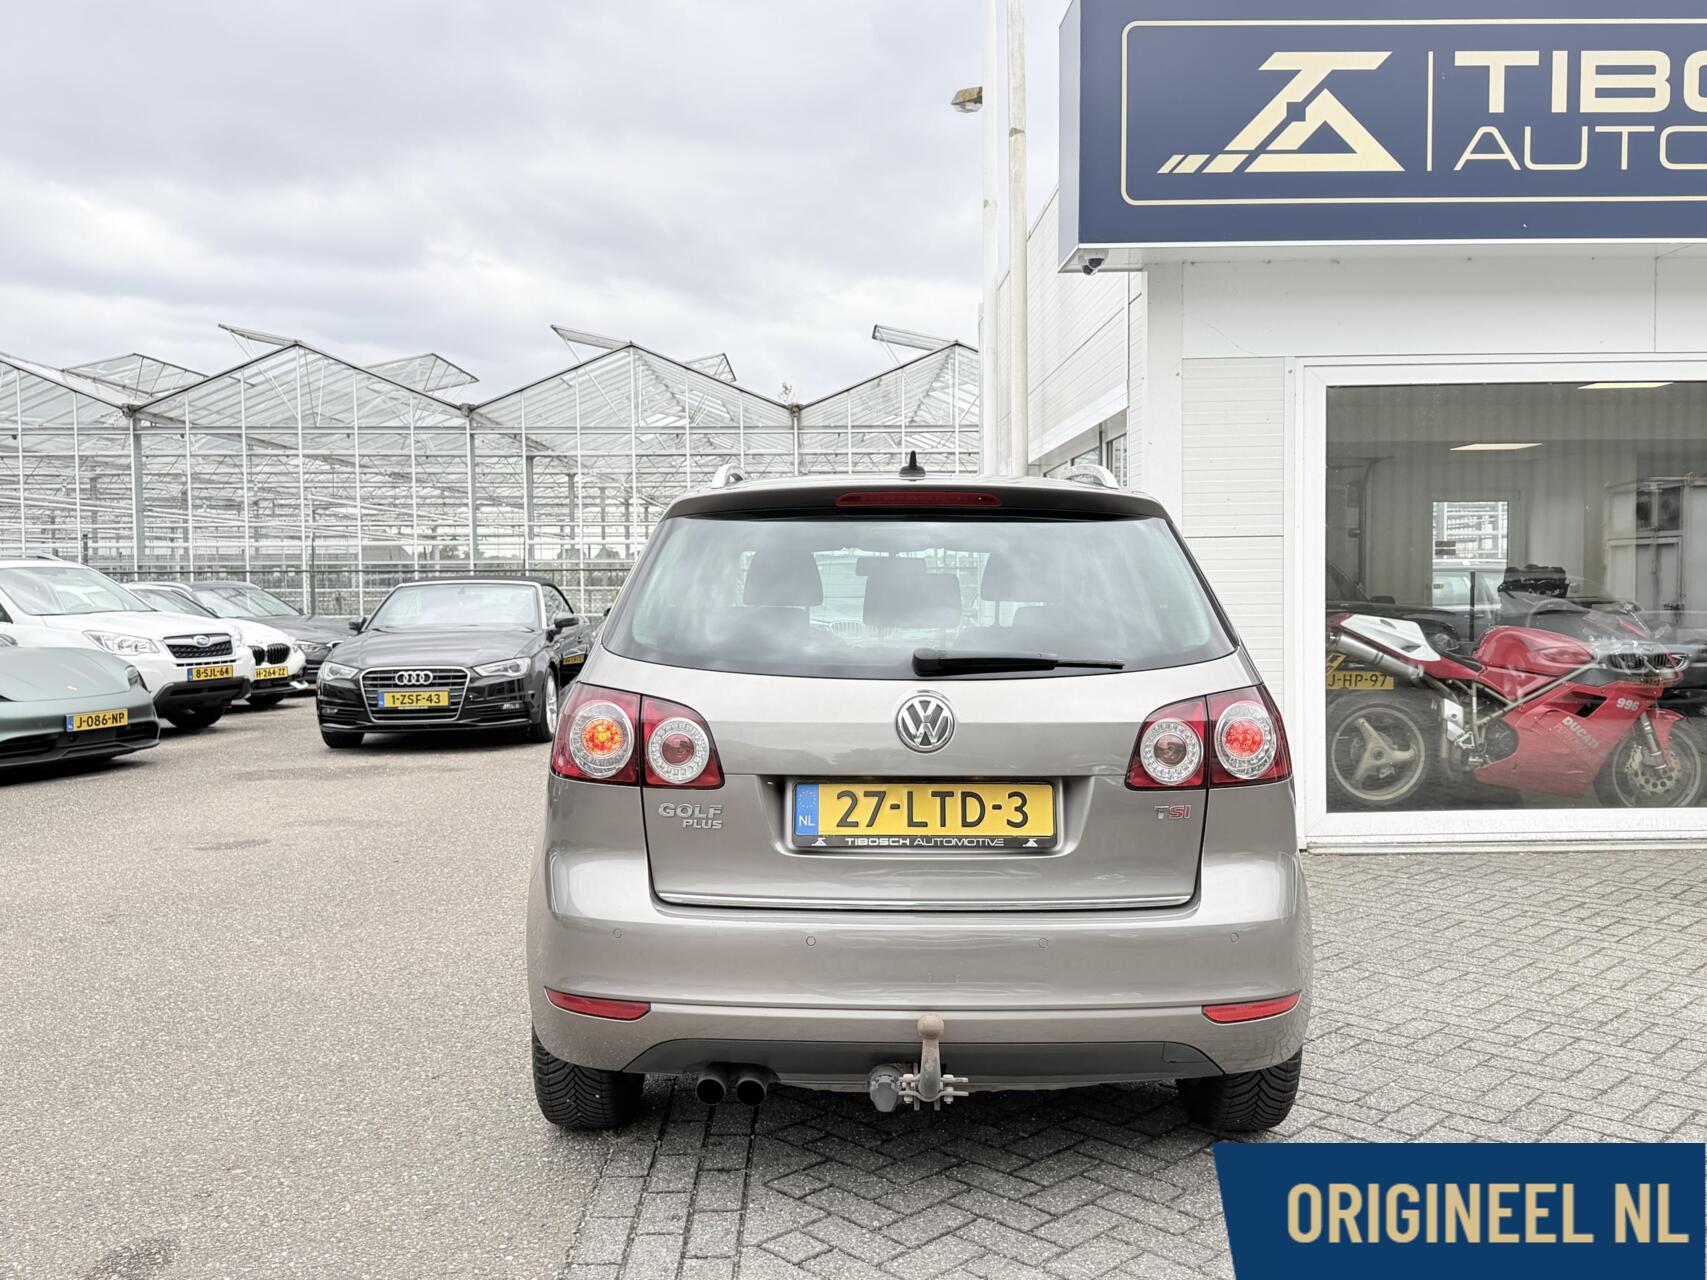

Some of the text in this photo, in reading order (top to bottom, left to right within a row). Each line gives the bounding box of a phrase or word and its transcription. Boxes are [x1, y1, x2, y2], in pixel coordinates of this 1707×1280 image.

[1454, 50, 1707, 113] TIB
[195, 667, 229, 678] 8-SJL-64
[391, 694, 441, 704] 1-ZSF-43
[1616, 697, 1640, 711] 996
[77, 712, 125, 728] J-086-NP
[1562, 716, 1600, 748] DUCATI
[658, 803, 723, 818] GOLF
[836, 790, 1029, 828] 27-LTD-3
[1153, 805, 1192, 820] TSI
[682, 819, 723, 829] PLUS
[798, 815, 815, 826] NL
[845, 838, 1005, 847] TIBOSCH AUTOMOTIVE
